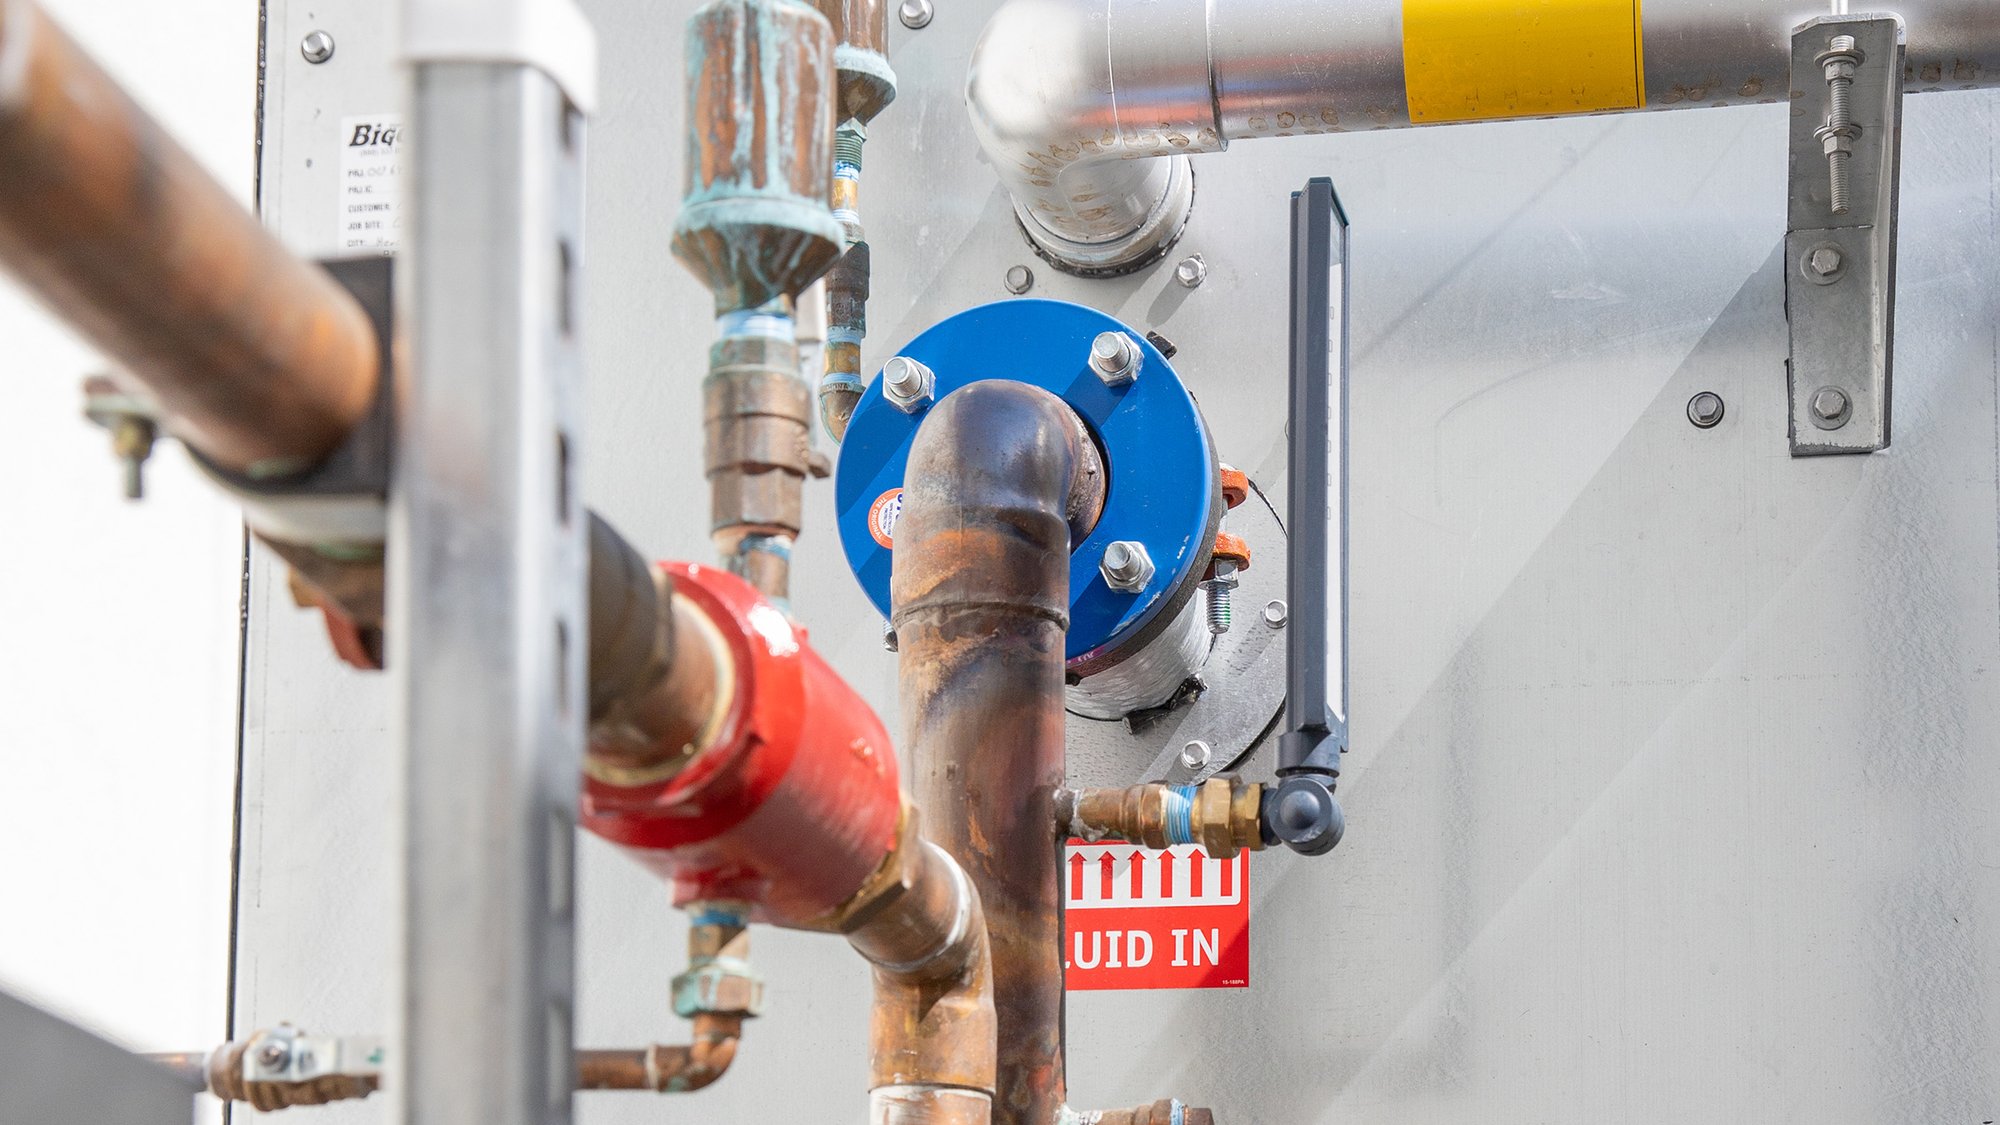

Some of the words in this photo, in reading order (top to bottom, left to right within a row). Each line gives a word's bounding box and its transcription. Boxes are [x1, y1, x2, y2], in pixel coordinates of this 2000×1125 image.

[871, 508, 883, 539] ORIGINAL
[1066, 930, 1153, 969] UID
[1171, 928, 1219, 966] IN
